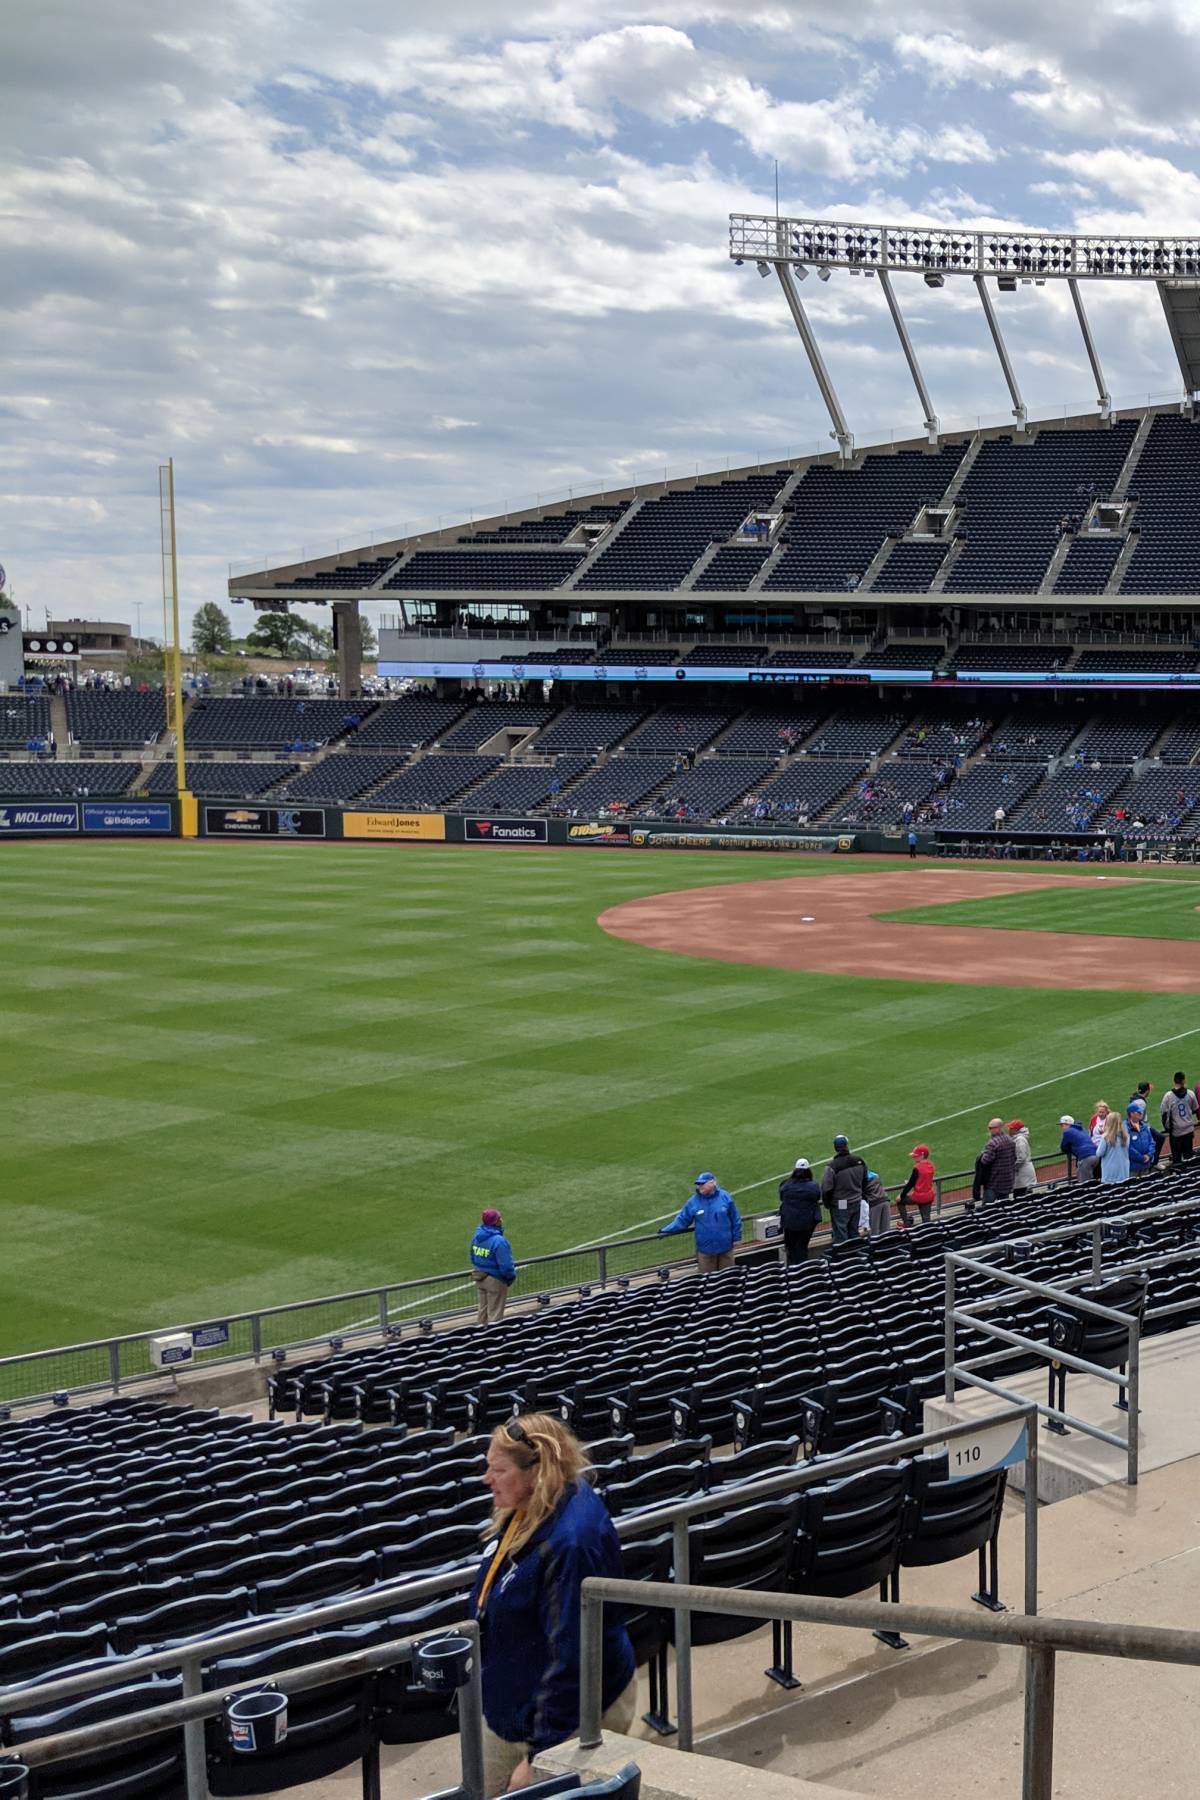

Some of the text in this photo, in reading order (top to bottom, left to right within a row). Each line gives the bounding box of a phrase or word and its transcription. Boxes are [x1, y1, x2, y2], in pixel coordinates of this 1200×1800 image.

[15, 812, 75, 824] MOLottery
[115, 816, 150, 826] Ballpark
[367, 817, 420, 827] Edward Jones
[493, 826, 536, 838] Fanatics
[651, 835, 676, 845] JOHN
[472, 1245, 490, 1258] TAFF
[956, 1446, 980, 1466] 110
